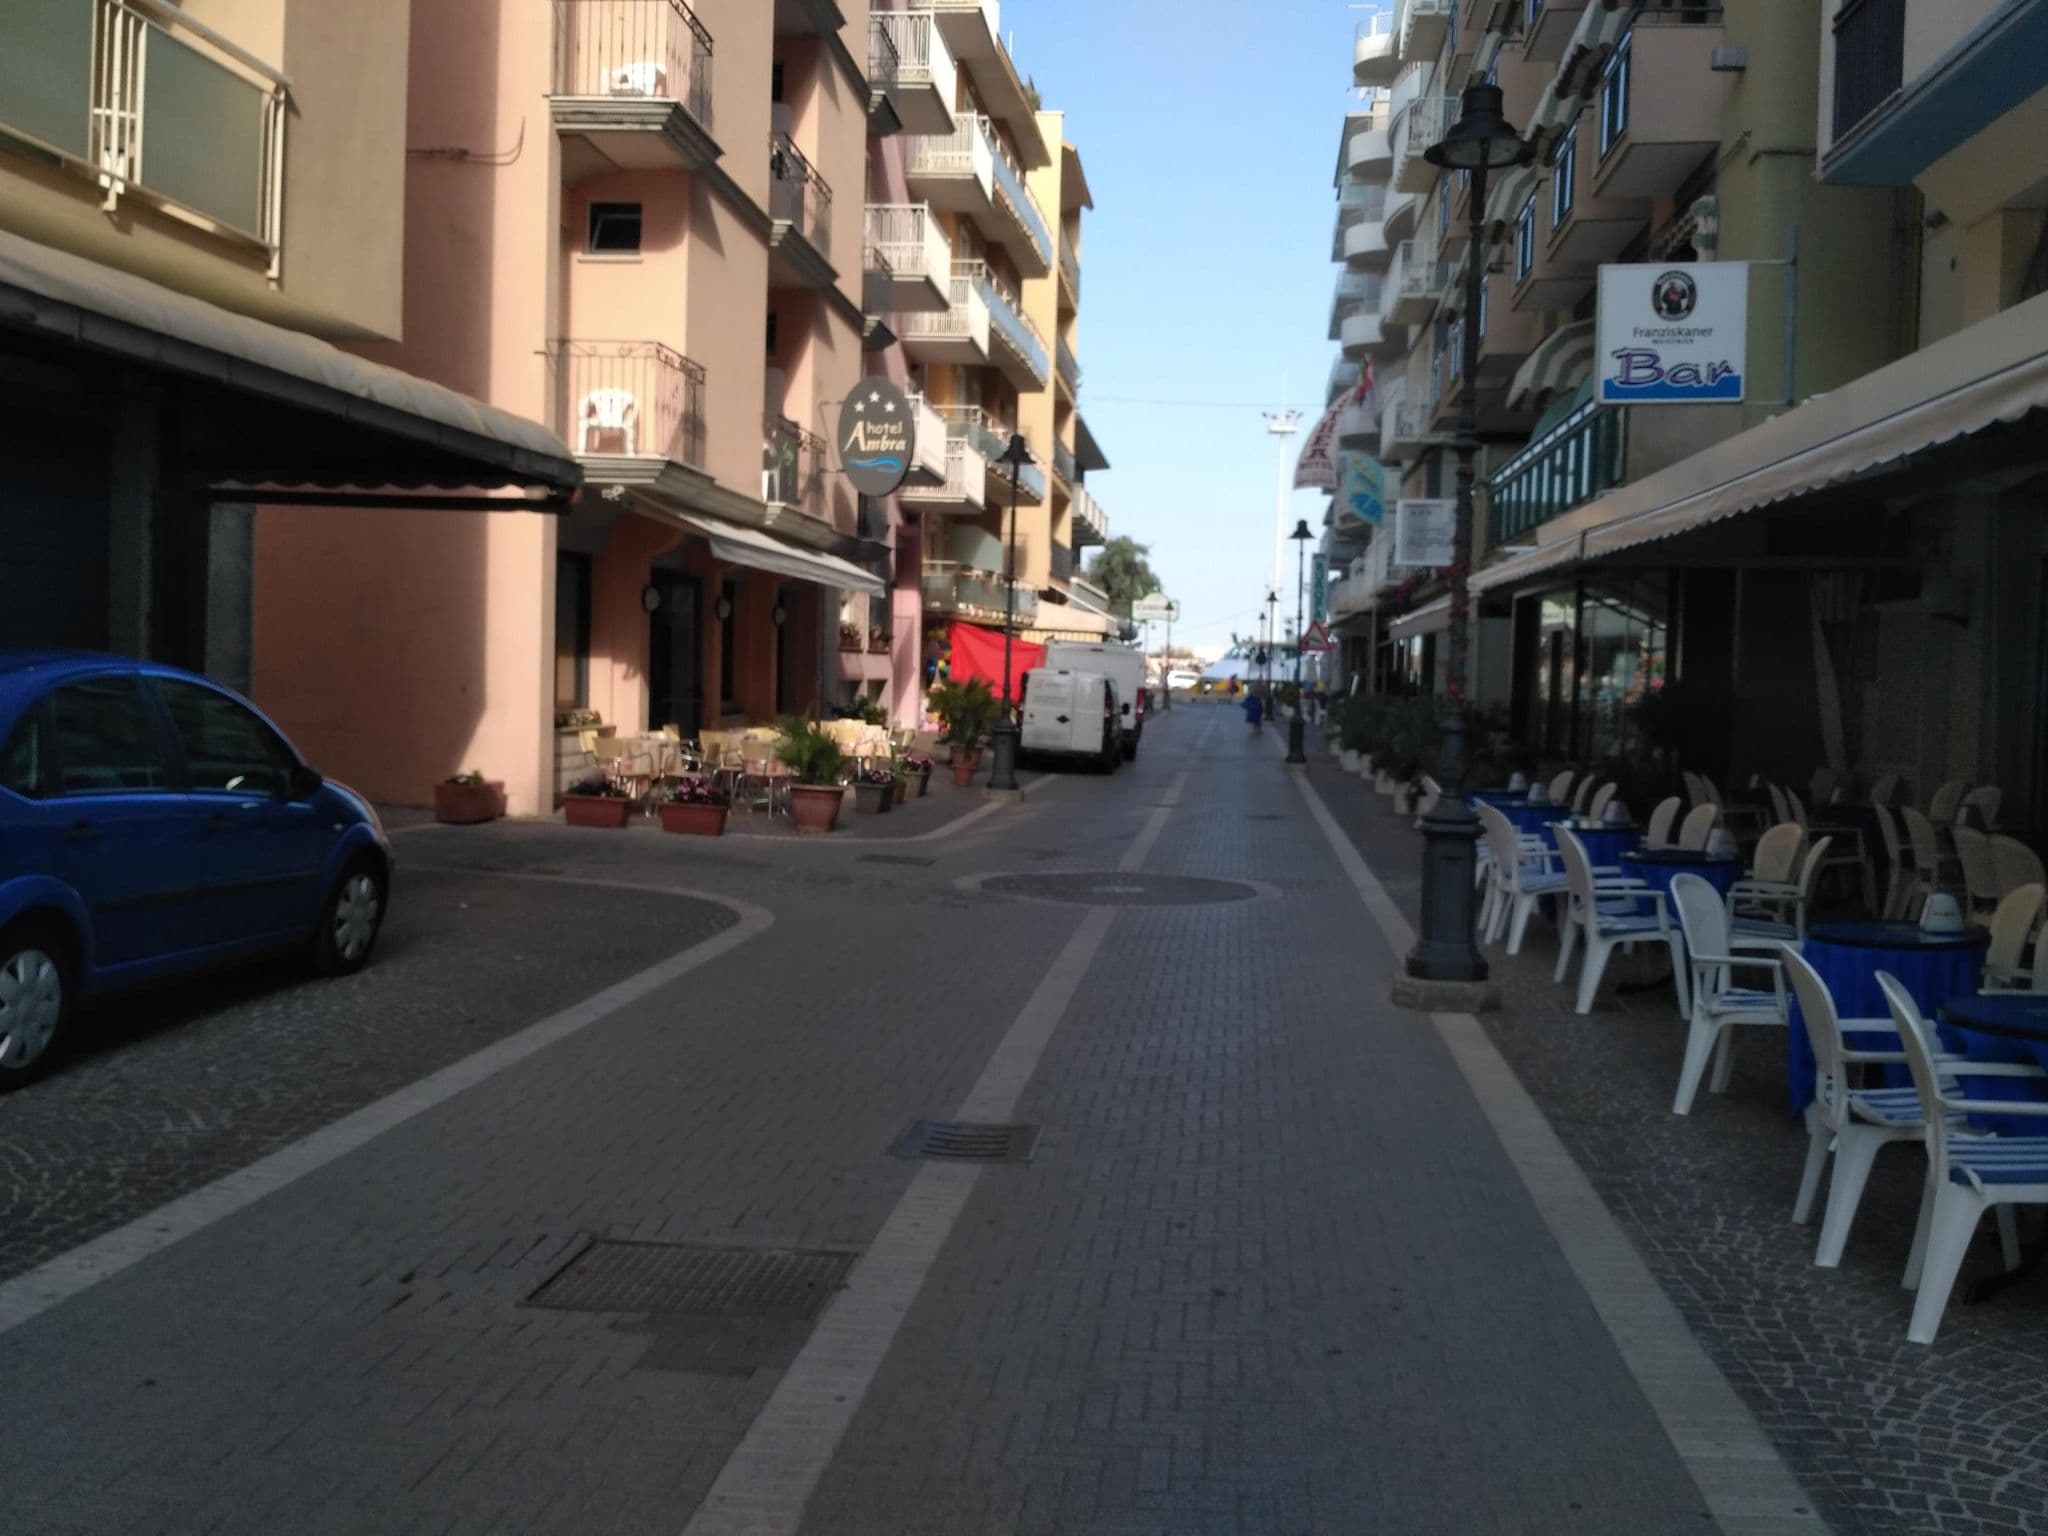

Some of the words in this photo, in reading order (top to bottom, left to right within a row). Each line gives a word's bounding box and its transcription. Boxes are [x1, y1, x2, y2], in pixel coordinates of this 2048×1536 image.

[1633, 327, 1714, 338] Franziskaner
[1611, 346, 1733, 386] Bar
[844, 420, 906, 452] Ambra
[866, 421, 902, 434] hotel
